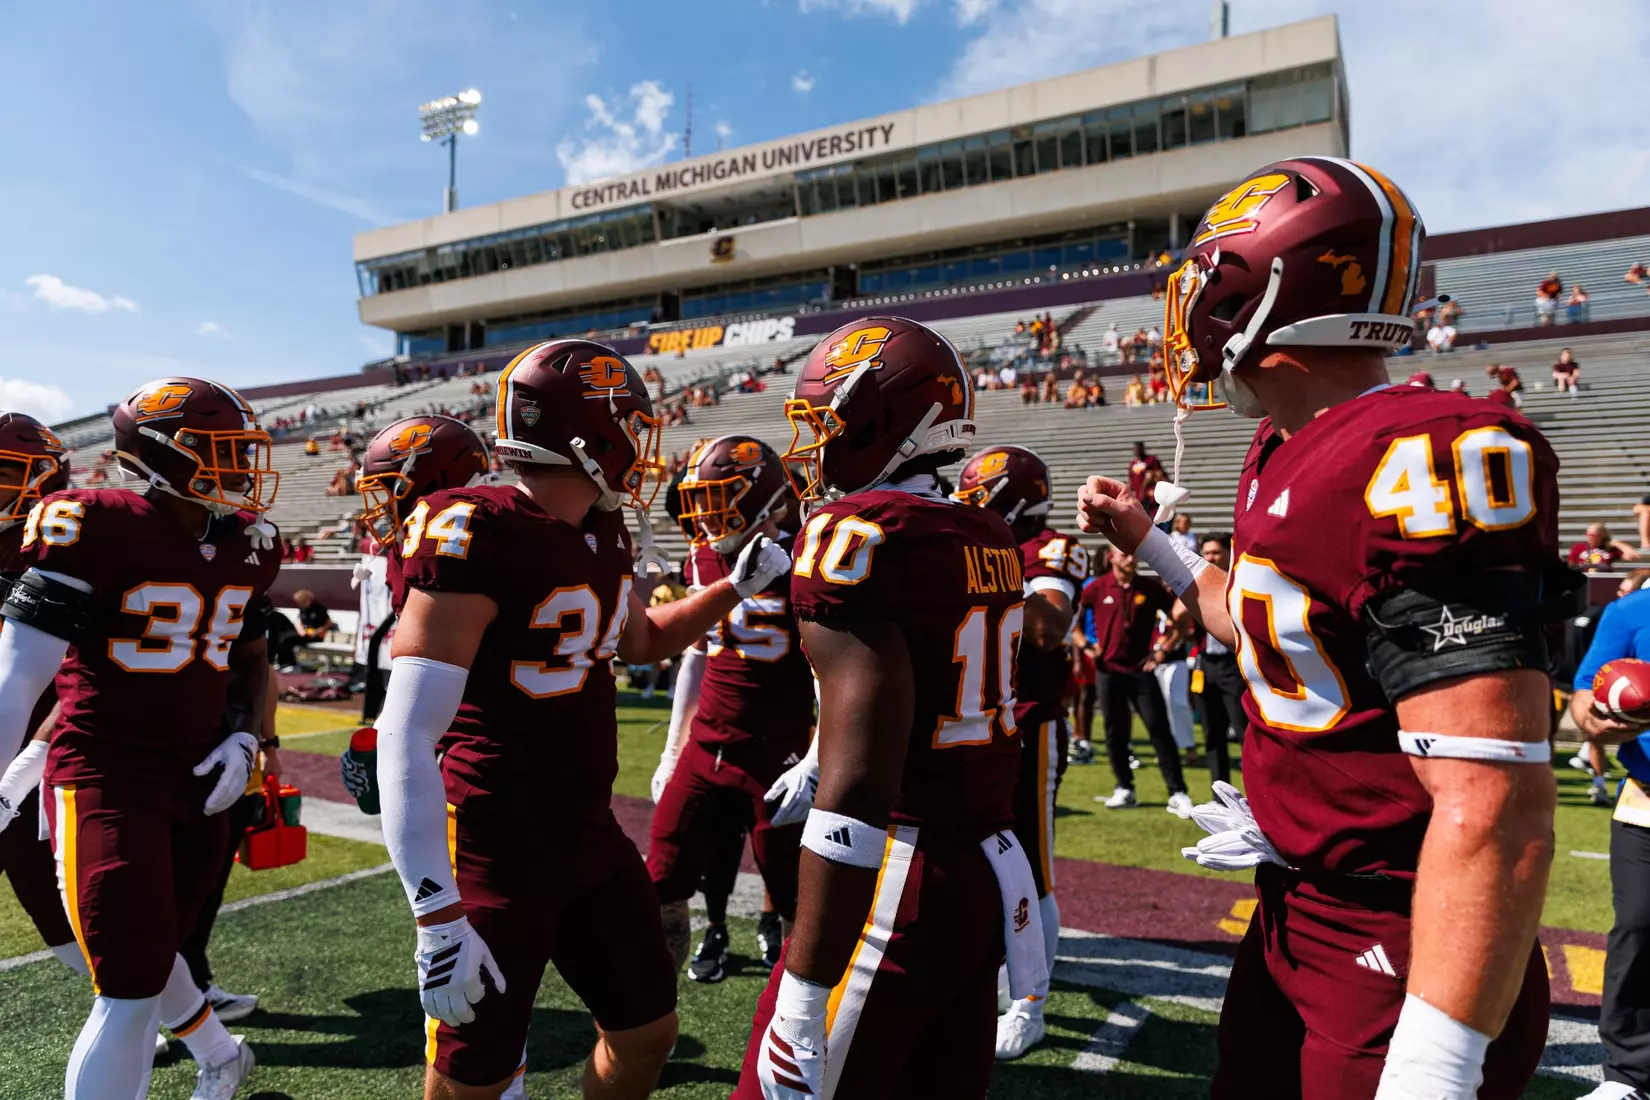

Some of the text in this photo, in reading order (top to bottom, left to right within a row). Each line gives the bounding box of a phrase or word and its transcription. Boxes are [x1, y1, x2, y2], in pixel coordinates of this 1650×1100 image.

[572, 122, 895, 209] CENTRAL MICHIGAN UNIVERSITY
[650, 316, 796, 352] FIRE UP CHIPS
[1364, 426, 1537, 540] 40
[401, 500, 477, 560] 34
[793, 513, 886, 586] 10
[1038, 537, 1089, 580] 49
[963, 545, 1023, 594] ALSTON
[1230, 551, 1352, 732] 0
